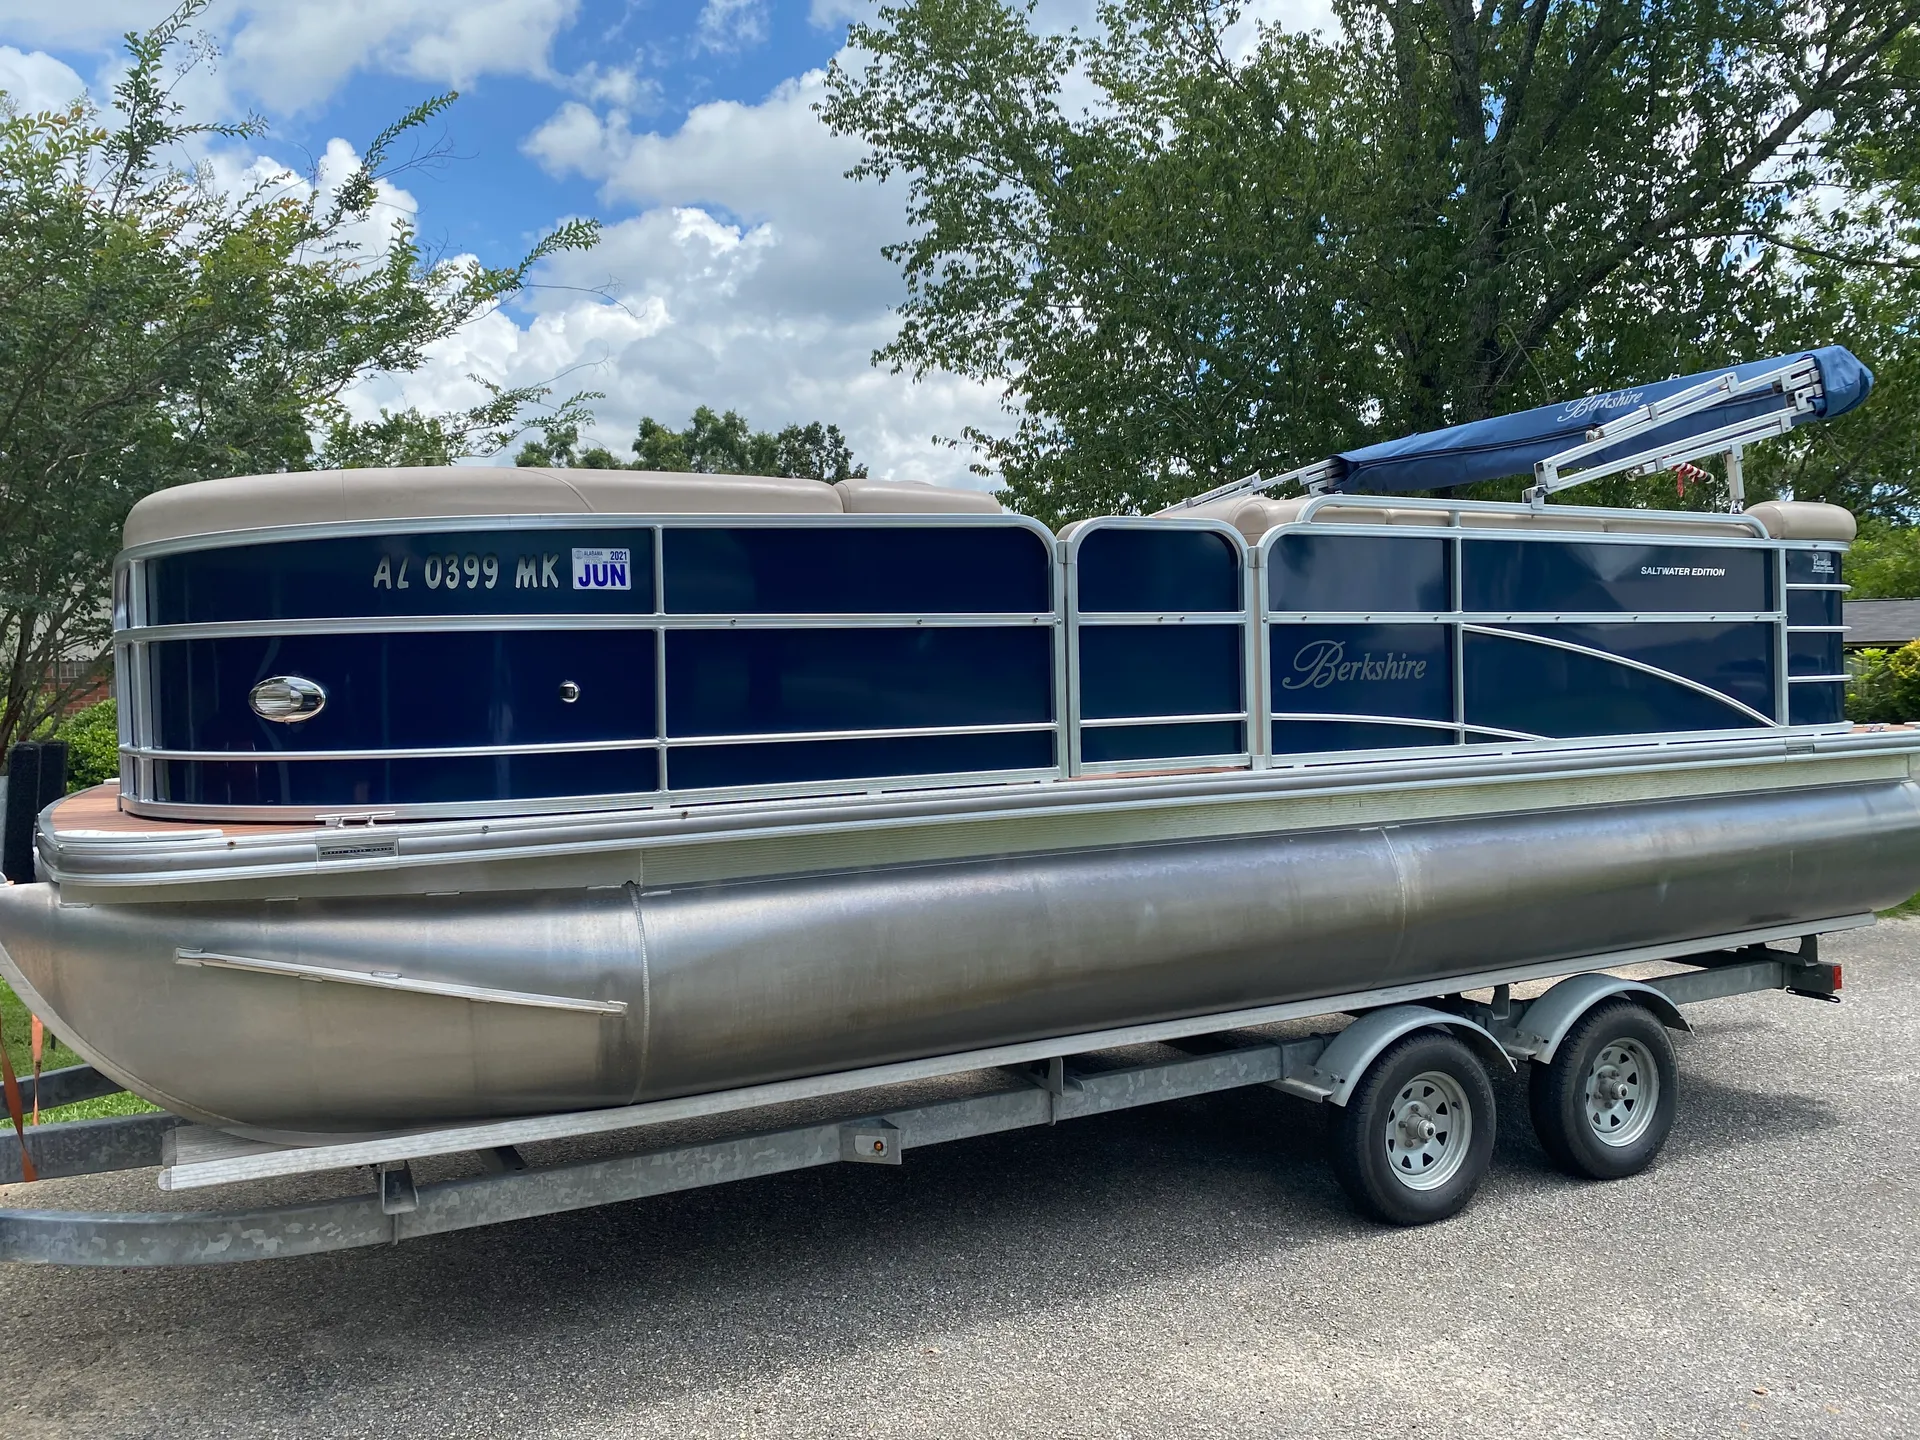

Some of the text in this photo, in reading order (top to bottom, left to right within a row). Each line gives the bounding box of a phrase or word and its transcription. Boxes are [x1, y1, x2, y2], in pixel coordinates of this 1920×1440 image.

[1557, 391, 1643, 422] Berkshire
[610, 551, 627, 560] 2021
[373, 553, 559, 589] AL 0399 MK
[578, 564, 626, 587] JUN
[1641, 566, 1726, 576] SALTWATER EDITION
[1282, 639, 1427, 690] Berkshire
